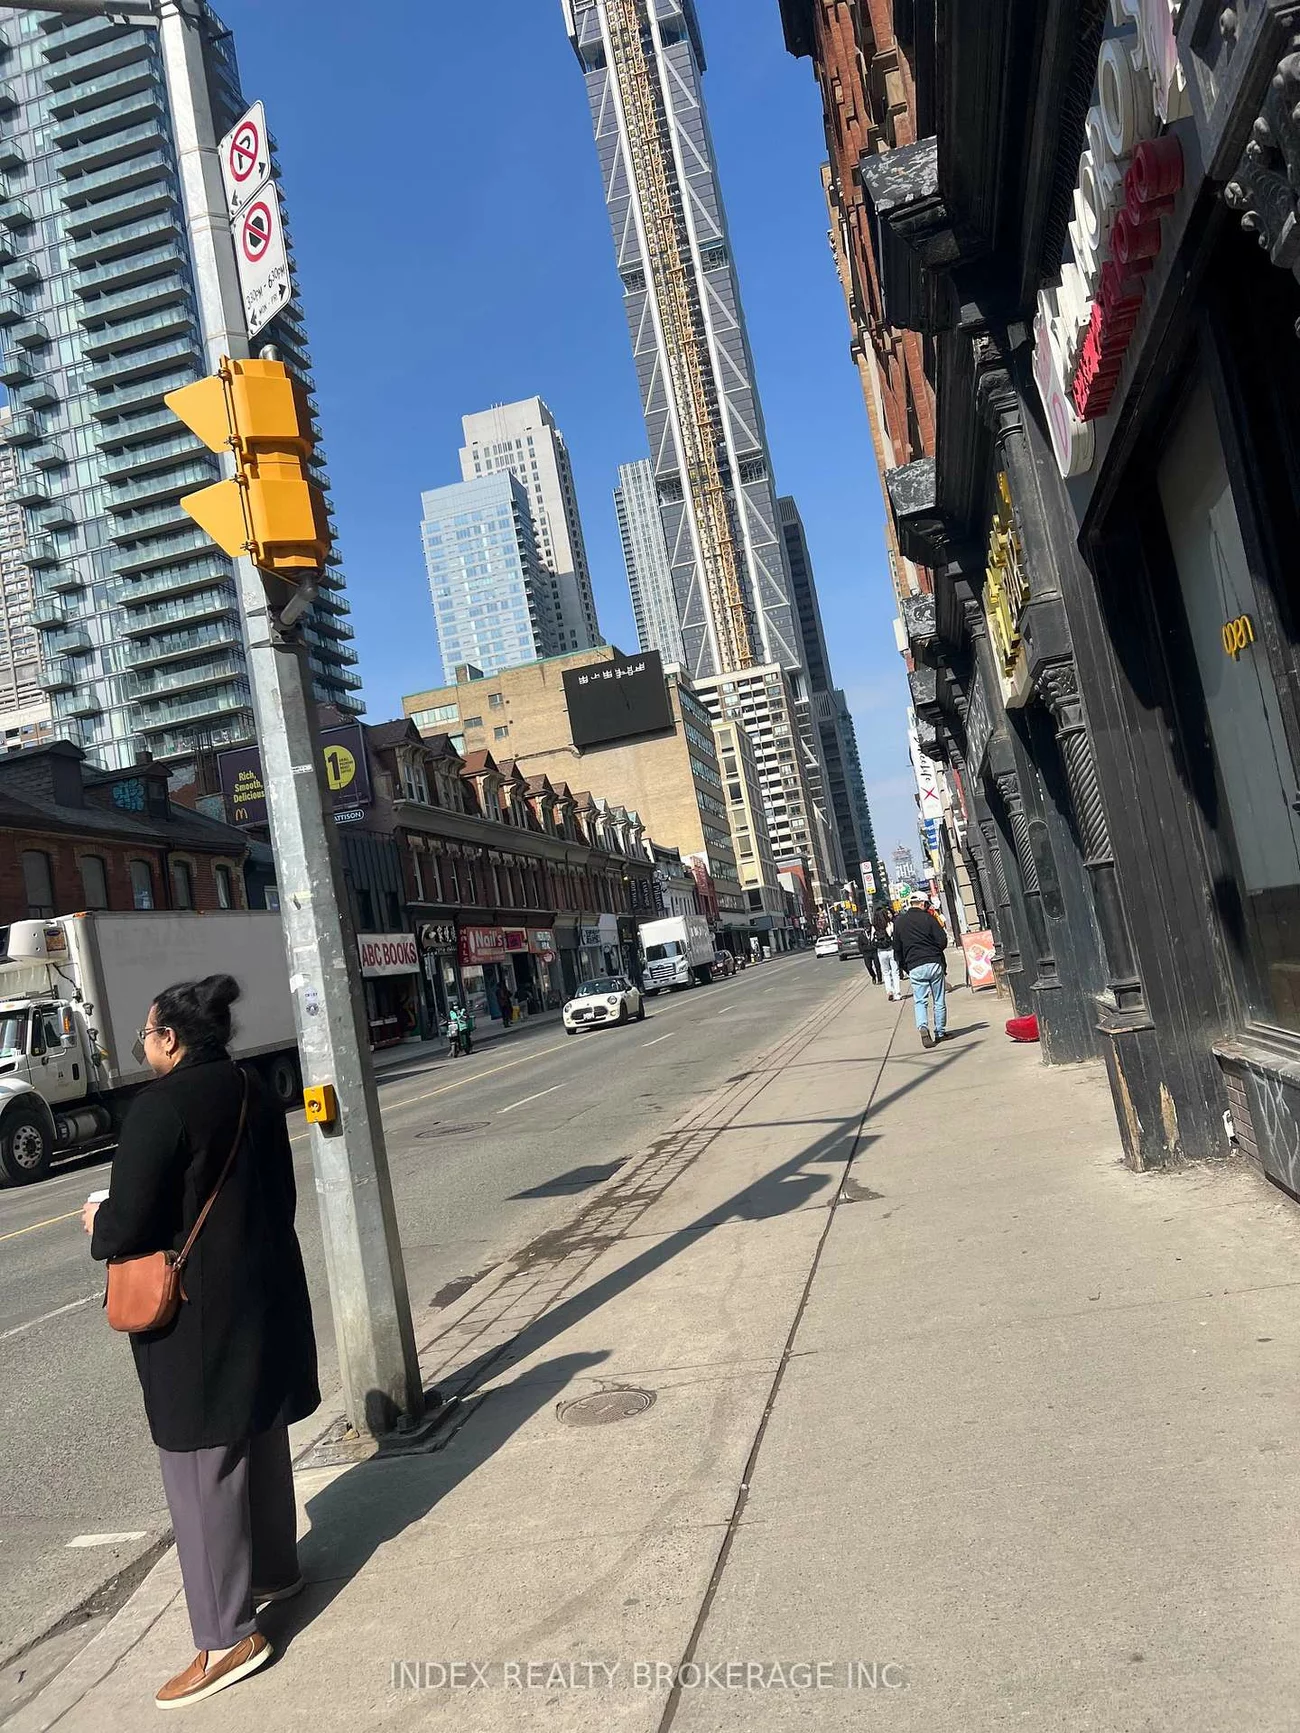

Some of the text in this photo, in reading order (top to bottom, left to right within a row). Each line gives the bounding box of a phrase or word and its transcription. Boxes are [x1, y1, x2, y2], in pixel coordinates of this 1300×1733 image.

[328, 752, 341, 781] 1
[238, 770, 256, 782] Rich,
[234, 780, 263, 793] Smooth,
[475, 930, 503, 948] Nail's
[362, 942, 418, 967] ABC BOOKS
